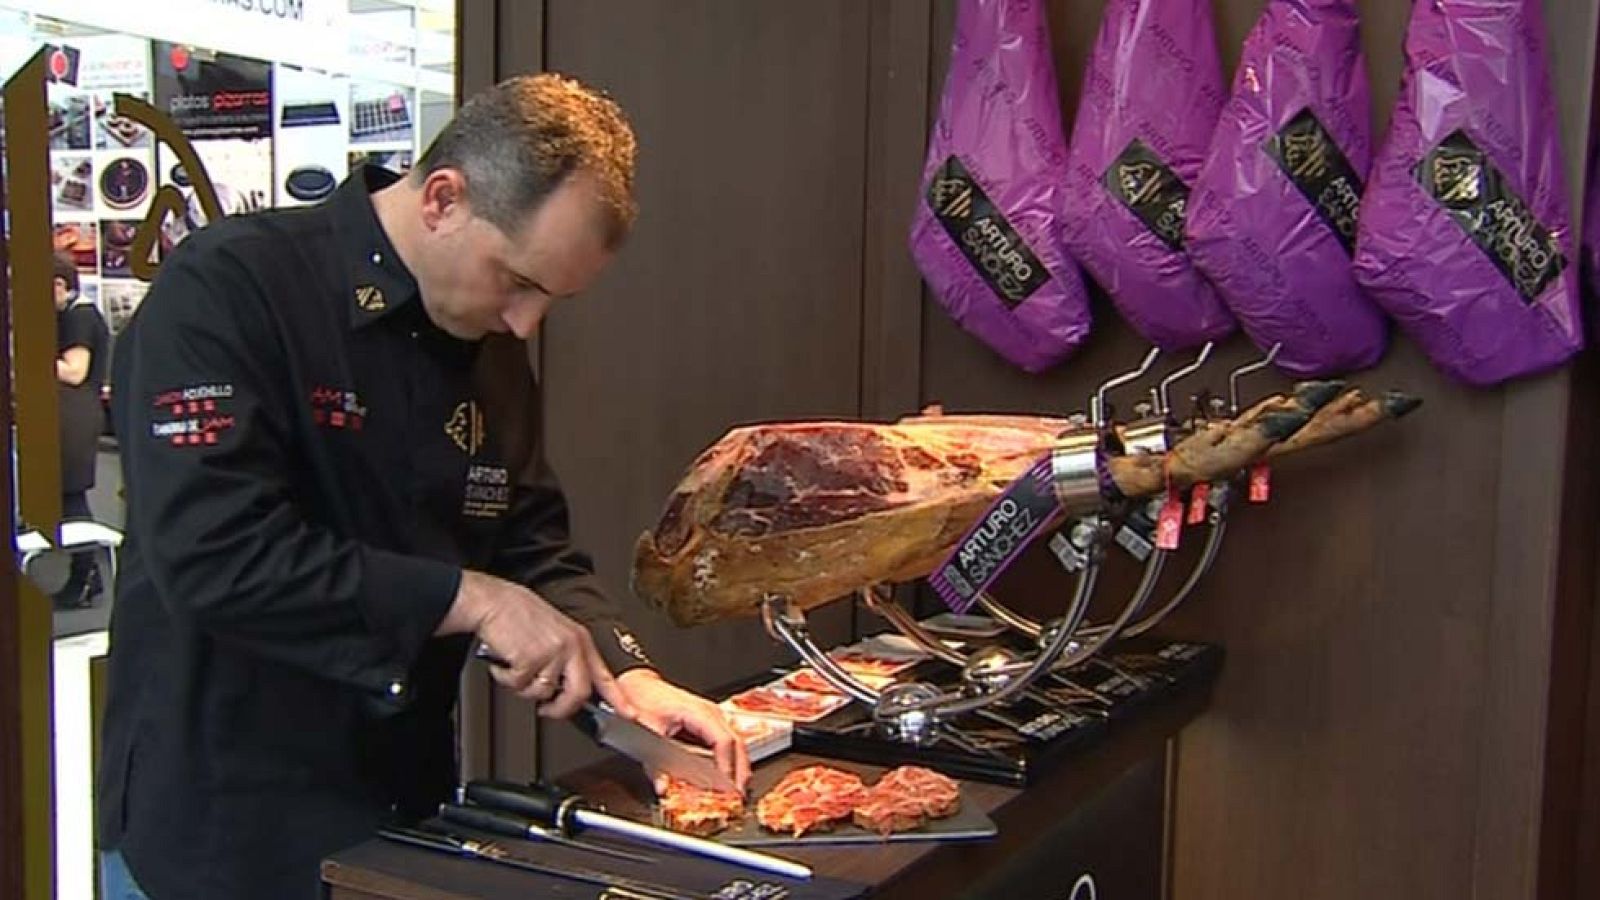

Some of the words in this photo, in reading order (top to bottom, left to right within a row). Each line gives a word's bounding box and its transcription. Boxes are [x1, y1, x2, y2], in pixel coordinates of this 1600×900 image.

[975, 218, 1032, 280] ARTURO
[1487, 200, 1548, 269] ARTURO
[959, 499, 1018, 569] ARTURO
